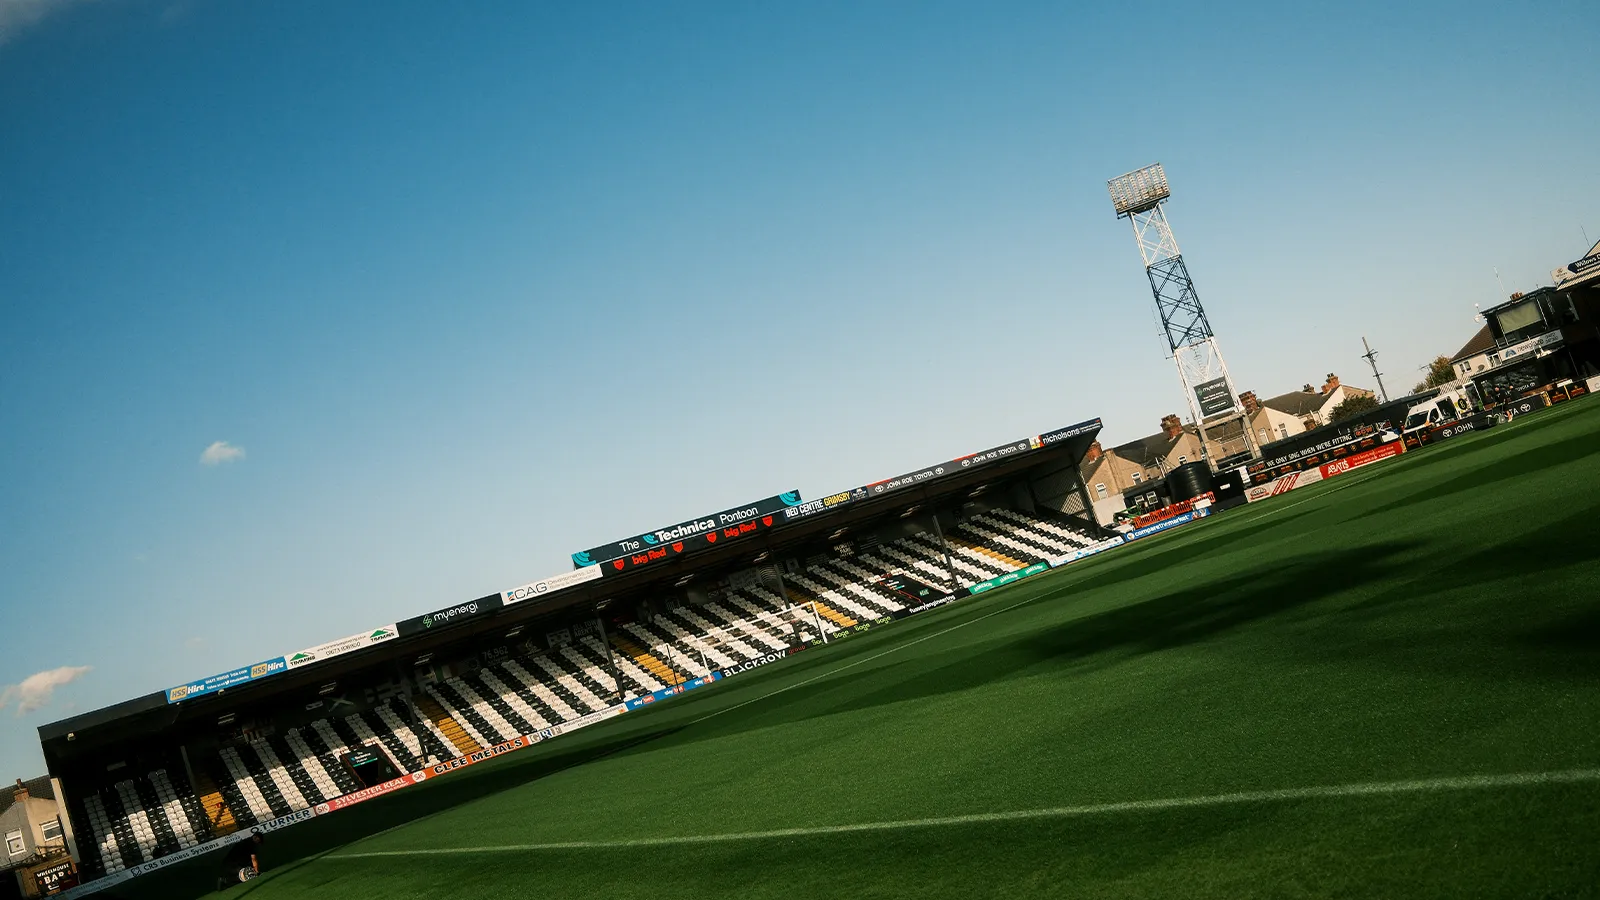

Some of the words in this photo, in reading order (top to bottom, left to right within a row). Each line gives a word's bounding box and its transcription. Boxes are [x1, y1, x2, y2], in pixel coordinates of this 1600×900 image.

[1042, 428, 1080, 444] nicholsons
[1454, 422, 1474, 434] JOHN
[972, 455, 986, 464] JOHN
[986, 452, 998, 460] ROE
[998, 446, 1018, 456] TOYOTA
[1300, 446, 1316, 457] WHEN
[1332, 434, 1352, 447] FITTING
[886, 480, 901, 490] JOHN
[902, 476, 914, 485] ROE
[914, 471, 934, 481] TOYOTA
[785, 508, 798, 518] BED
[799, 500, 824, 514] CENTRE
[824, 492, 851, 507] GRIMSBY
[618, 538, 640, 552] The
[655, 518, 716, 542] Technica
[720, 506, 759, 525] Pontoon
[724, 526, 739, 539] big
[738, 520, 757, 534] Red
[1134, 514, 1190, 537] comparethemarket
[631, 552, 648, 566] big
[648, 547, 666, 560] Red
[514, 582, 548, 600] CAG
[433, 601, 478, 622] myenergi
[370, 632, 394, 642] TIMMINS
[290, 656, 316, 666] TIMMINS
[480, 645, 508, 662] 76,962
[723, 650, 787, 678] BLACKROW
[788, 645, 806, 656] group
[252, 666, 266, 676] HSS
[268, 662, 284, 672] Hire
[171, 688, 186, 698] HSS
[187, 684, 205, 694] Hire
[434, 758, 468, 774] CLEE
[471, 739, 524, 762] METALS
[414, 772, 424, 780] SK
[335, 784, 382, 806] SYLVESTER
[383, 777, 407, 789] KEAL
[260, 810, 310, 830] TURNER
[144, 862, 158, 871] CRS
[160, 852, 190, 866] Business
[190, 842, 220, 856] Systems
